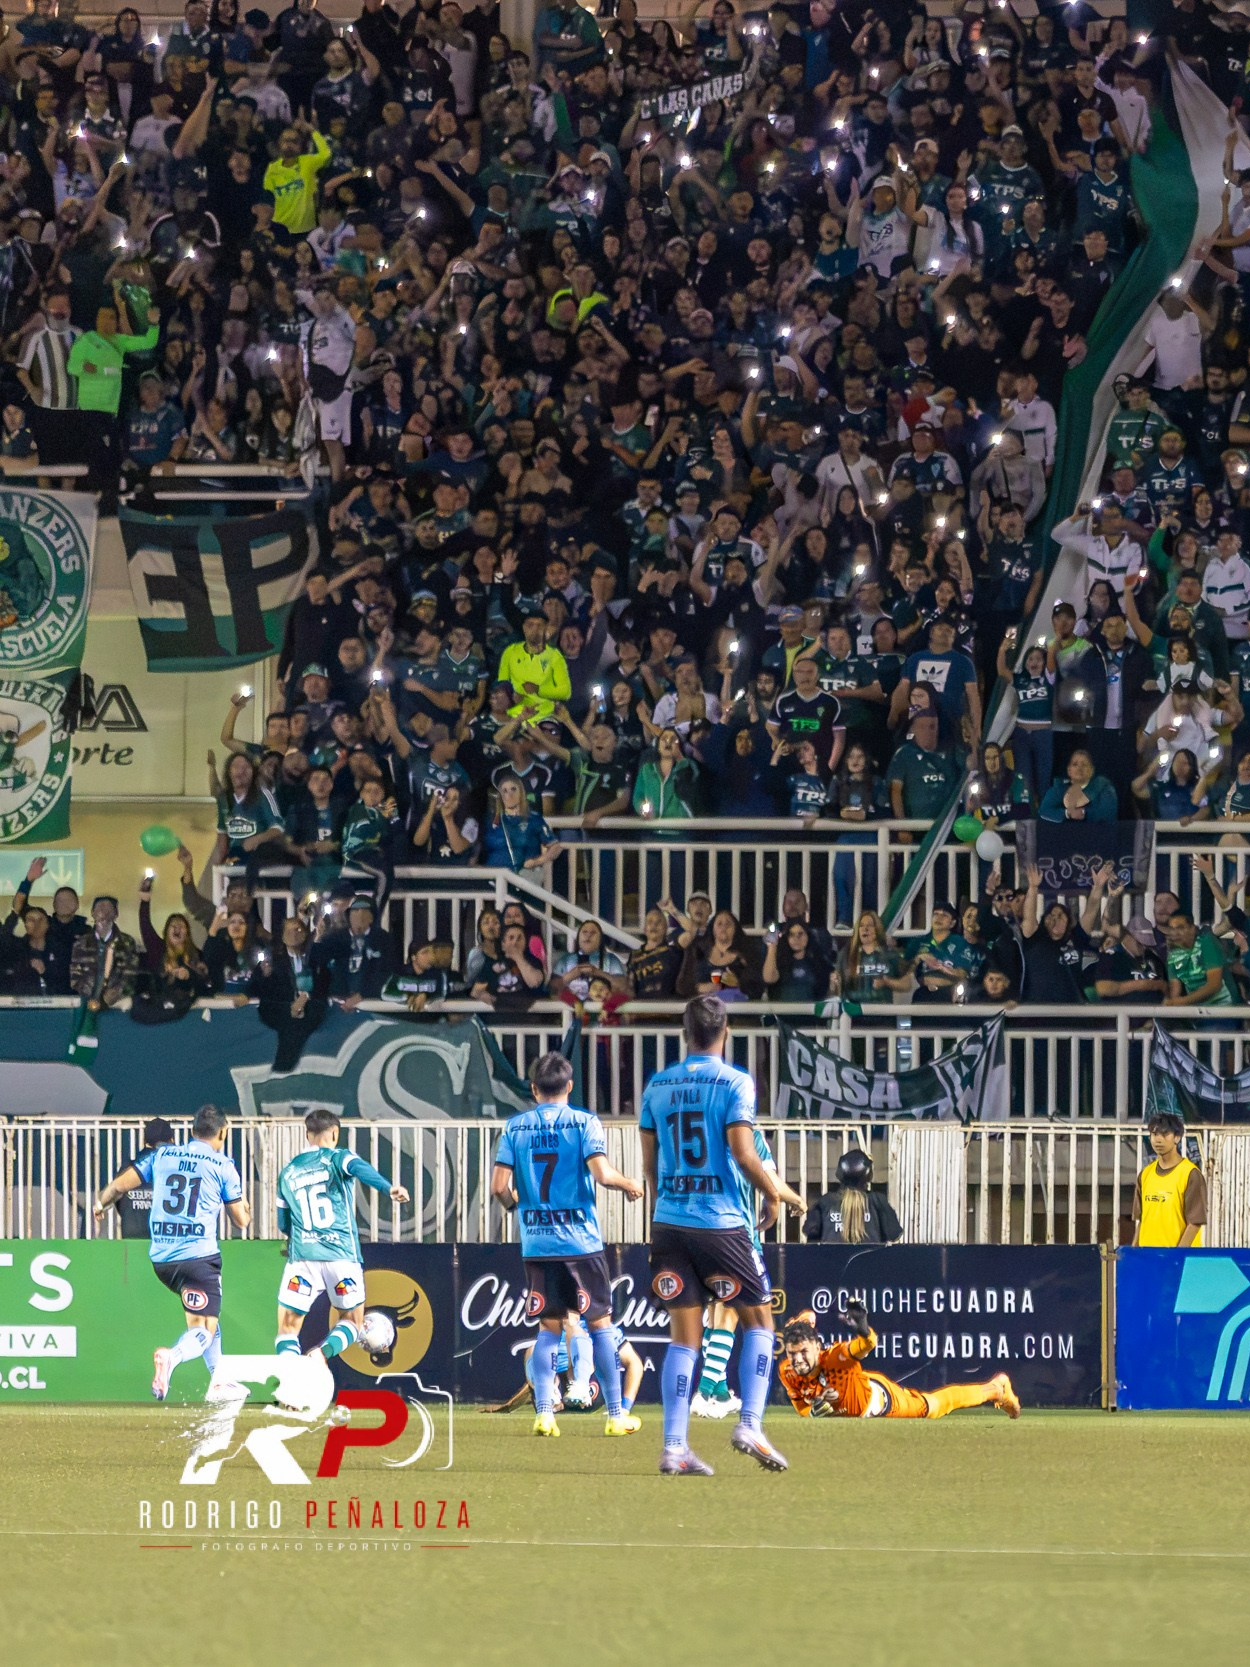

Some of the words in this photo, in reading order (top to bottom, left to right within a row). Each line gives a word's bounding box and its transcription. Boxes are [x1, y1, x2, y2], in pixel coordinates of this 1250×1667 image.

[820, 680, 858, 690] TPS
[1019, 686, 1049, 702] TPS
[791, 719, 821, 732] TPS
[787, 1038, 902, 1110] CASA
[670, 1089, 700, 1106] AYALA
[511, 1120, 586, 1132] COLLAHUASI
[530, 1134, 560, 1149] JONES
[666, 1110, 707, 1170] 15
[533, 1153, 560, 1202] 7
[162, 1173, 202, 1218] 31
[293, 1183, 335, 1231] 16
[153, 1222, 206, 1237] MSTR
